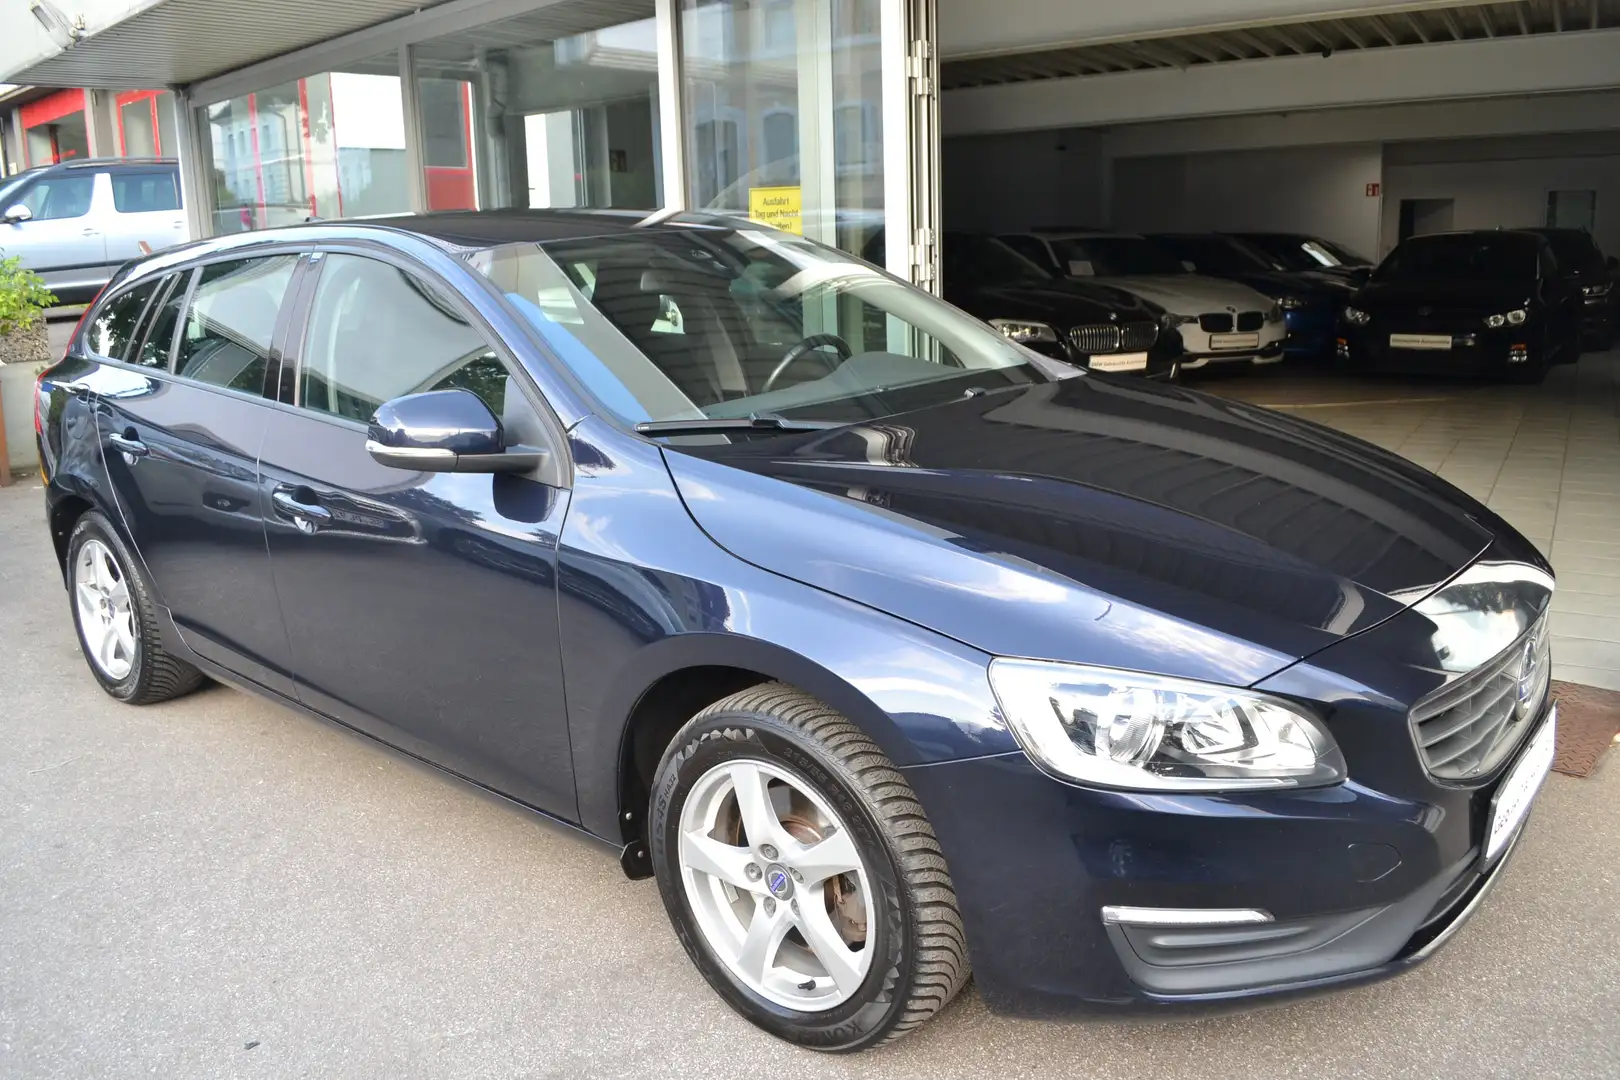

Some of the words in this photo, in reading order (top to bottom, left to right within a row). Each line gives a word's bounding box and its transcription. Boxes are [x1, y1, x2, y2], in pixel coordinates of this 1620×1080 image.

[763, 197, 789, 206] Ausfahrt
[755, 209, 765, 219] Tag
[766, 209, 778, 217] und
[780, 208, 799, 217] Nacht
